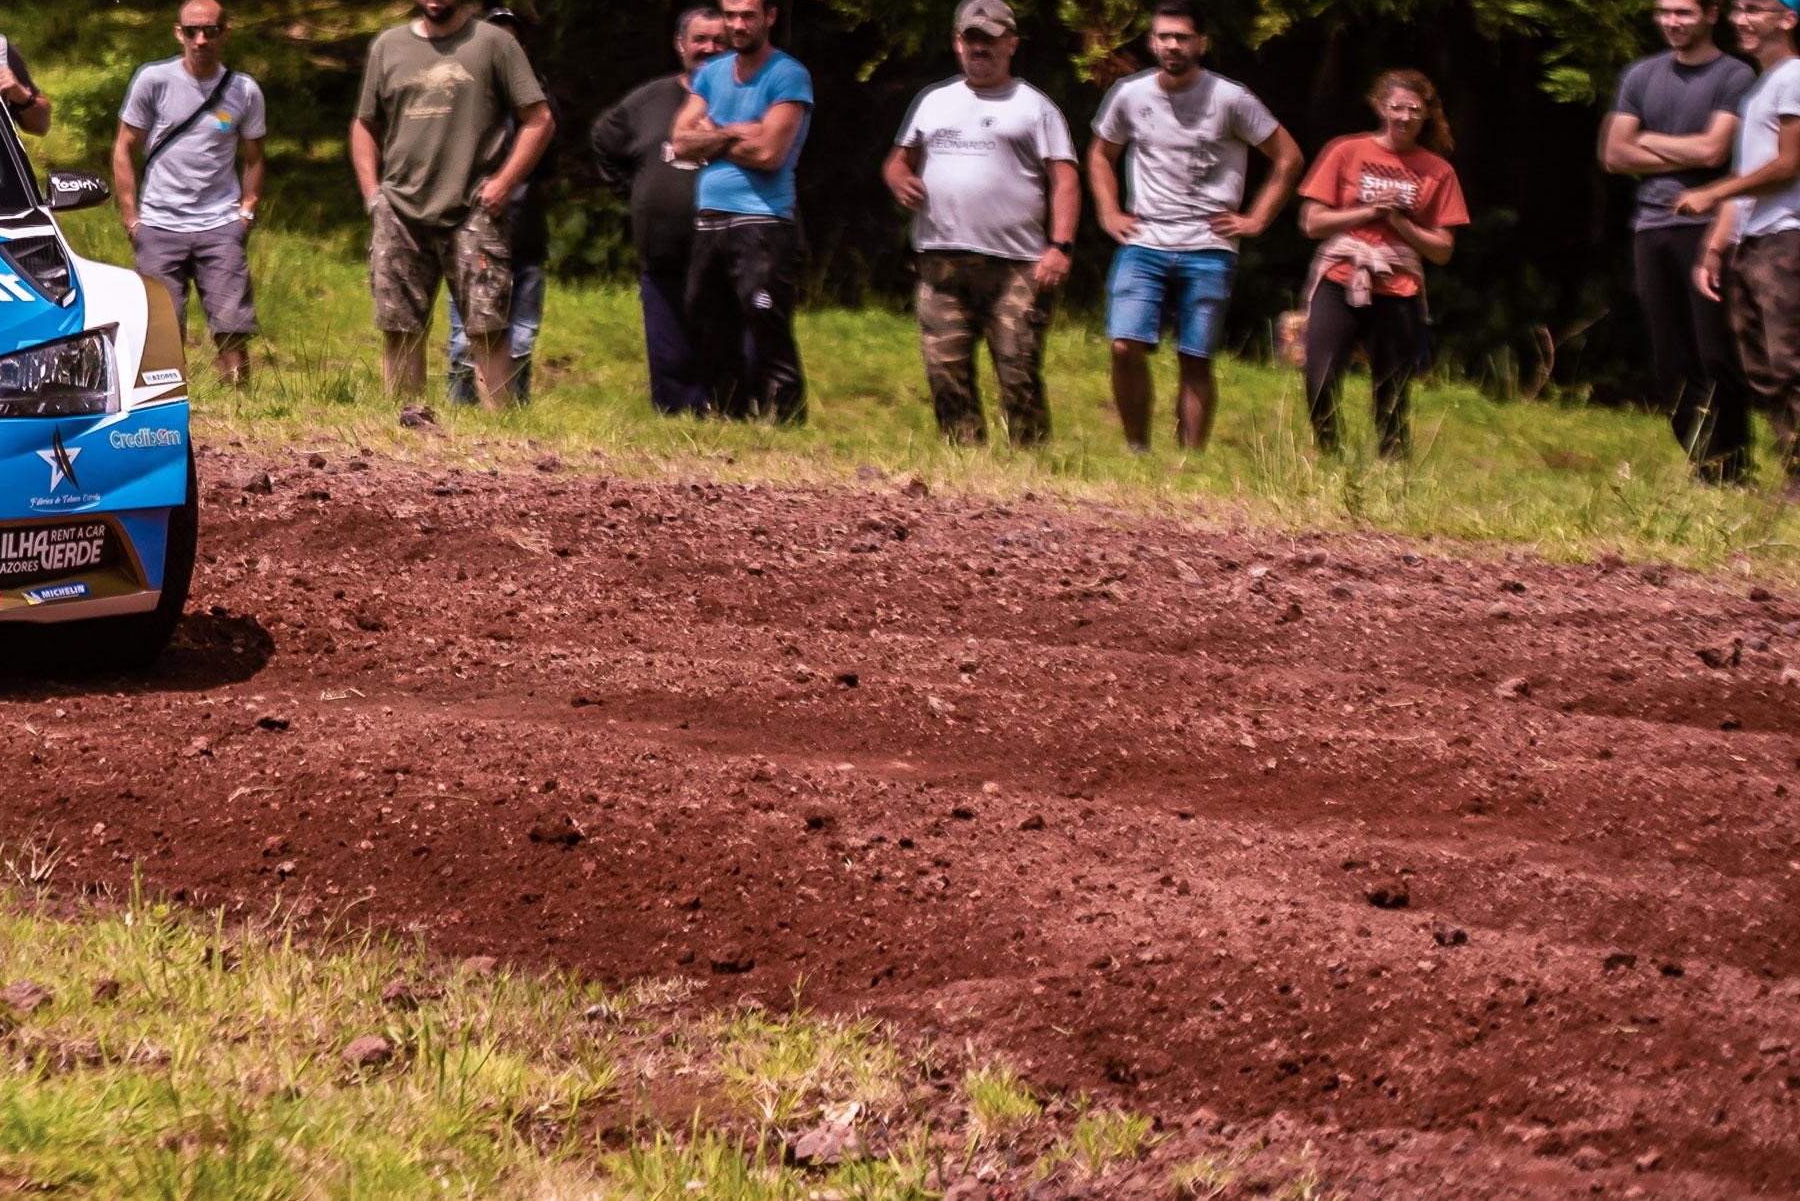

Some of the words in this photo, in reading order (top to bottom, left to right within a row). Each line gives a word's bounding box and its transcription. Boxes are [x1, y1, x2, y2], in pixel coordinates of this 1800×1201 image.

[51, 527, 77, 542] RENT
[77, 526, 84, 540] A
[85, 524, 106, 538] CAR
[1, 530, 49, 559] ILHA
[0, 560, 39, 574] AZORES
[41, 584, 85, 599] MICHELIN
